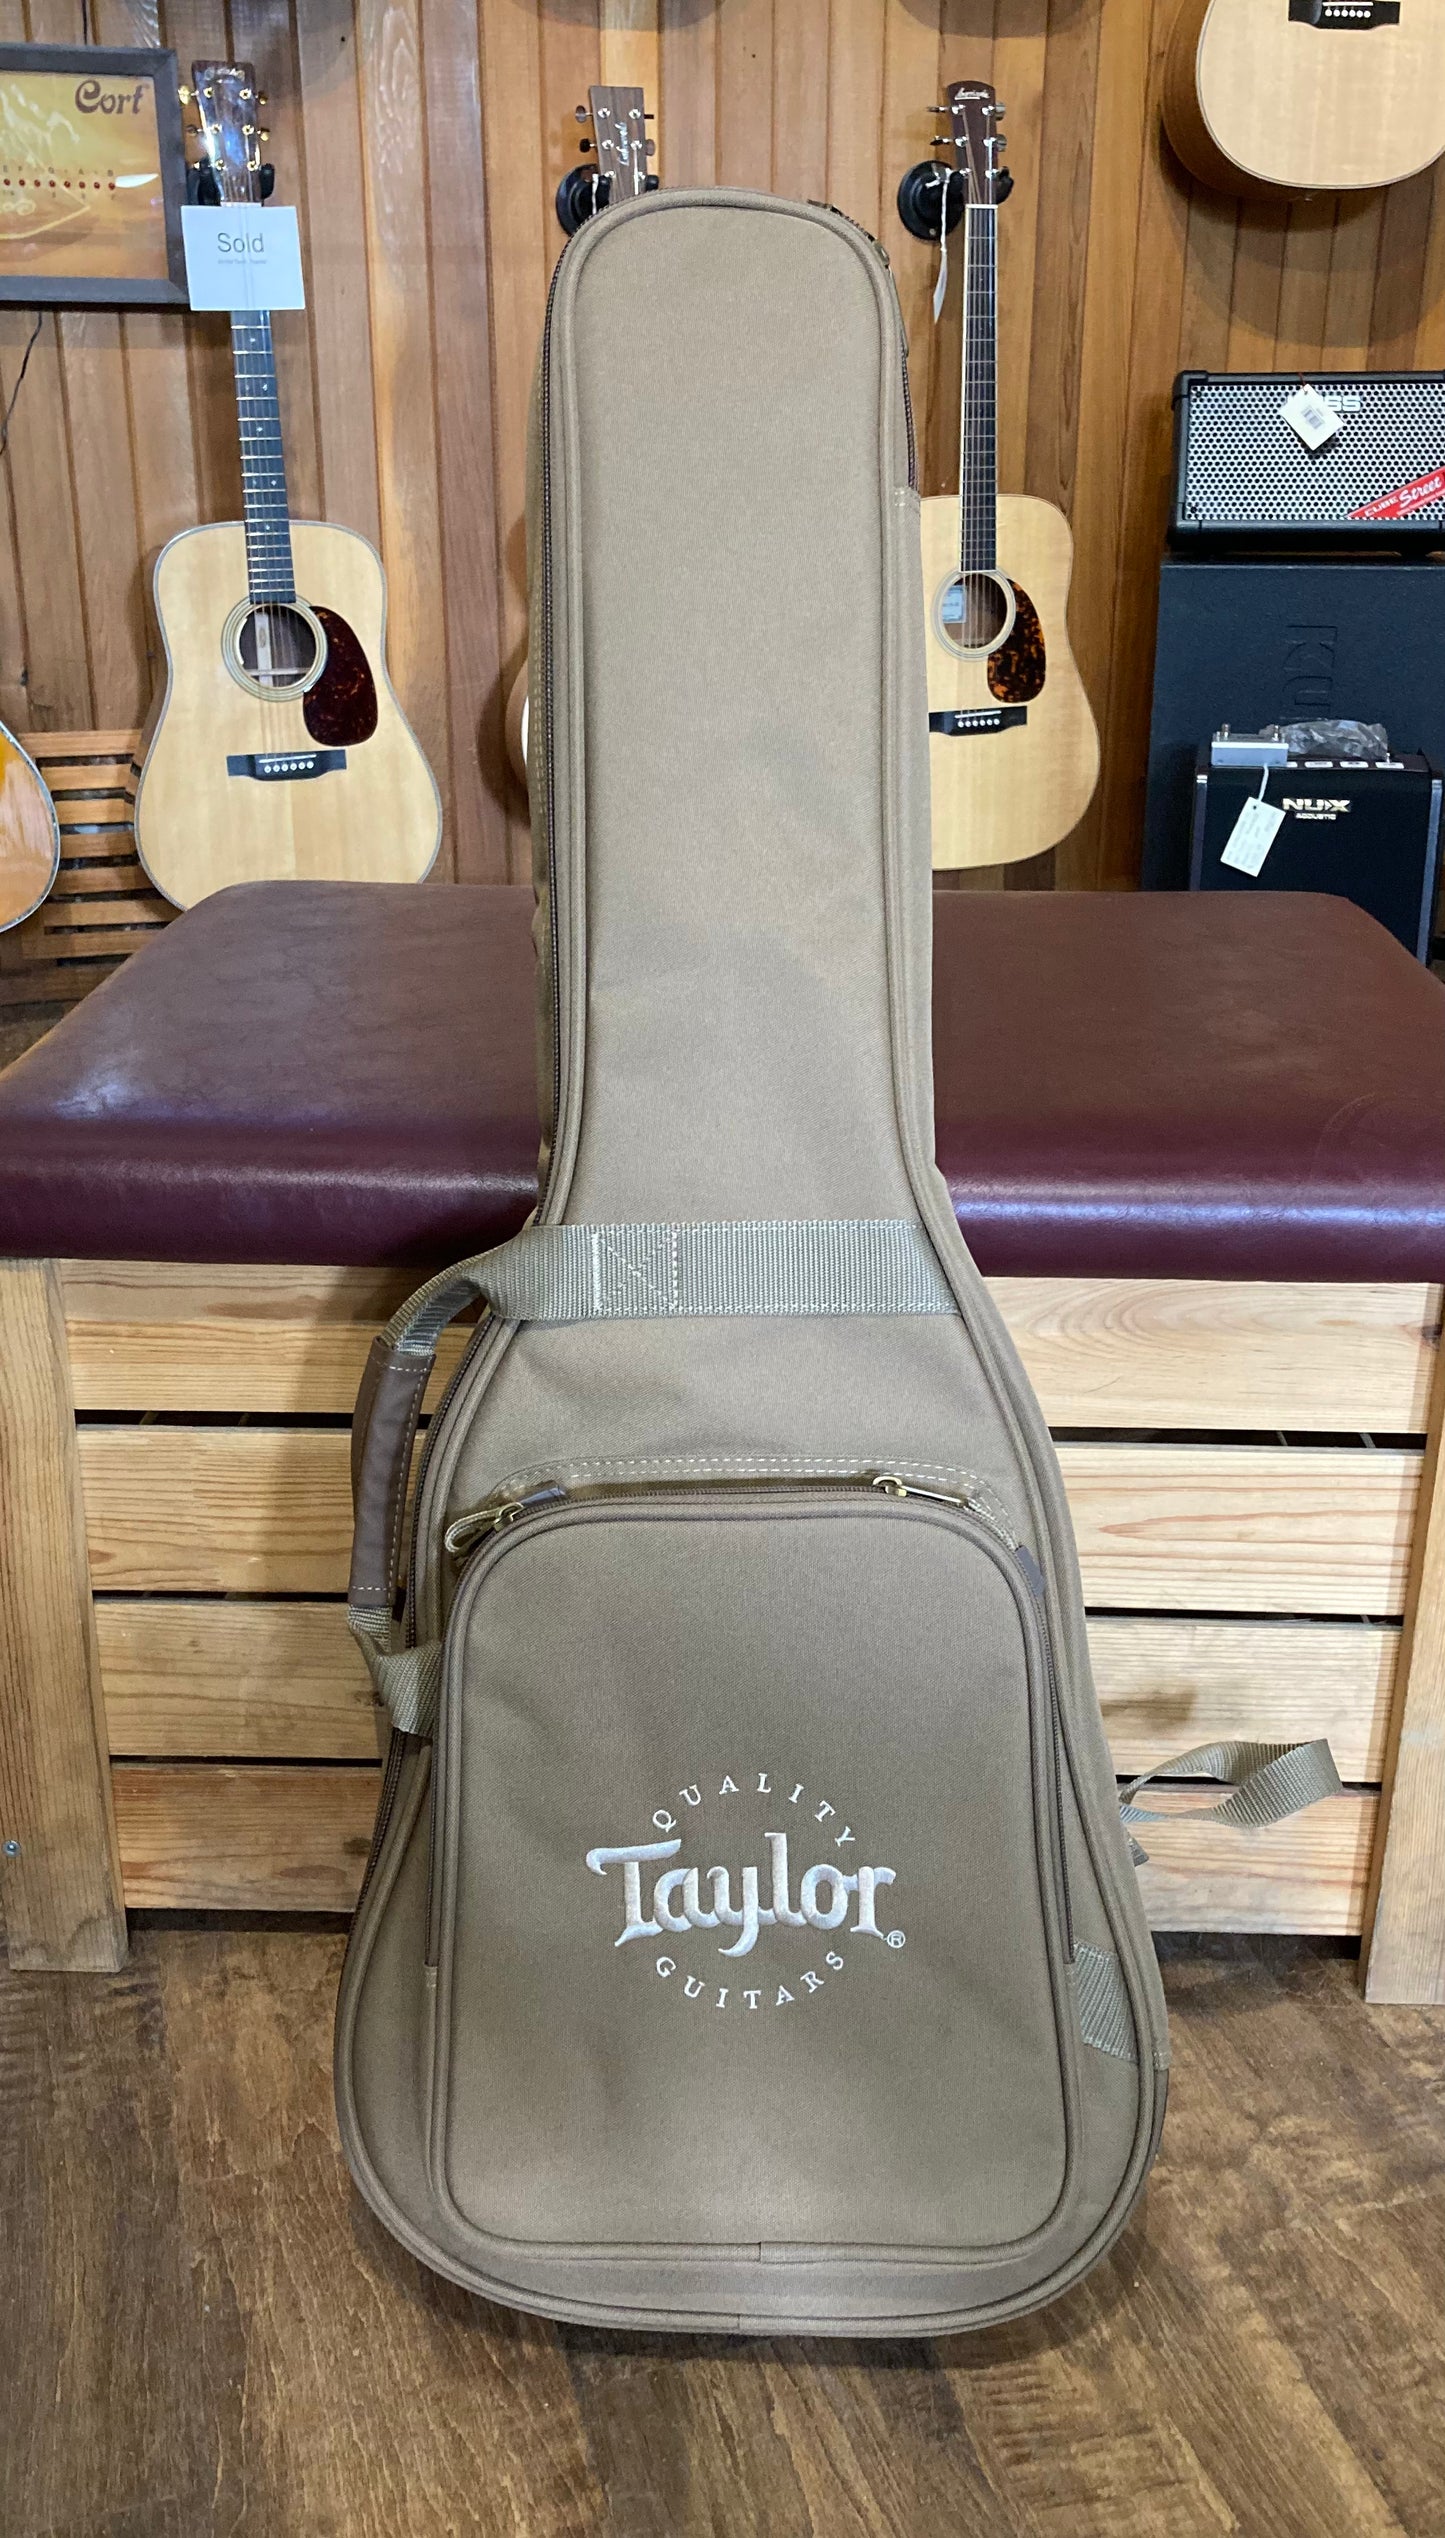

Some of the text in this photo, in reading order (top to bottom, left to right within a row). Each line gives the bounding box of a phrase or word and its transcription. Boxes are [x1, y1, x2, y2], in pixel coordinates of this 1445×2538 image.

[75, 79, 144, 115] Cort
[217, 232, 265, 253] Sold
[1399, 476, 1442, 508] Street
[1282, 798, 1351, 813] NUX
[653, 1773, 855, 1847] QUALITY
[586, 1832, 897, 1957] Taylor
[656, 1951, 844, 2009] GUITARS
